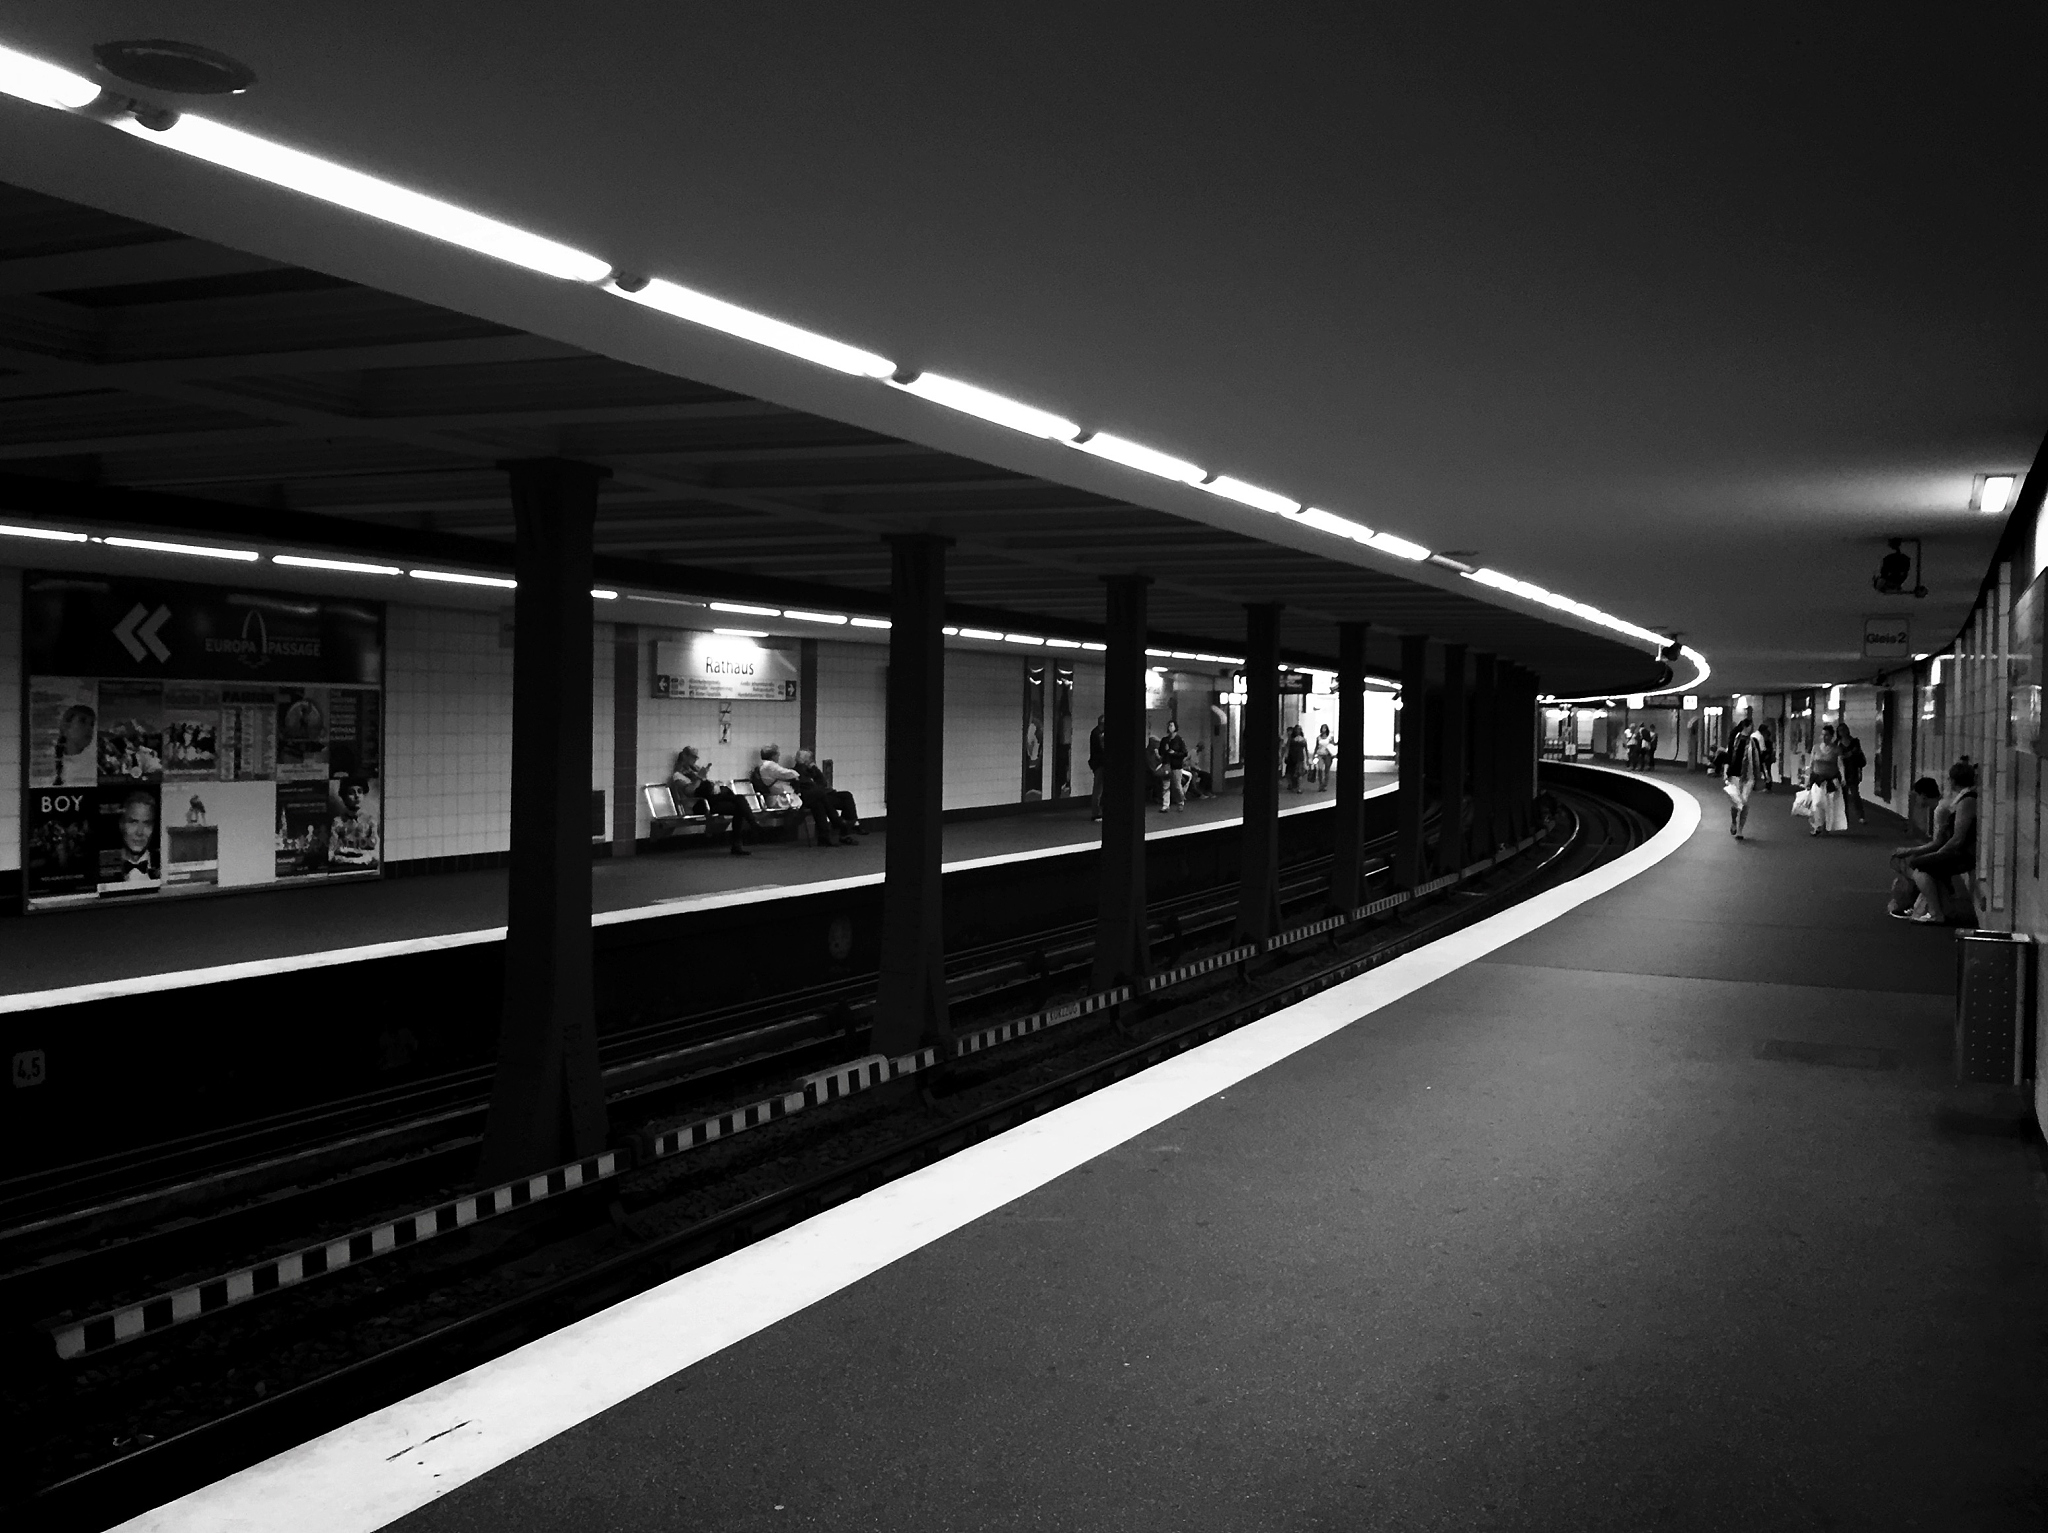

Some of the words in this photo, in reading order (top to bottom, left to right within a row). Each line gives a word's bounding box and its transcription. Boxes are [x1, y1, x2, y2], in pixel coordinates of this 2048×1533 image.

[1898, 632, 1907, 643] 2
[205, 638, 257, 653] EUROPA
[268, 641, 321, 657] PASSAGE
[705, 656, 755, 676] Rathaus
[40, 794, 85, 814] BOY
